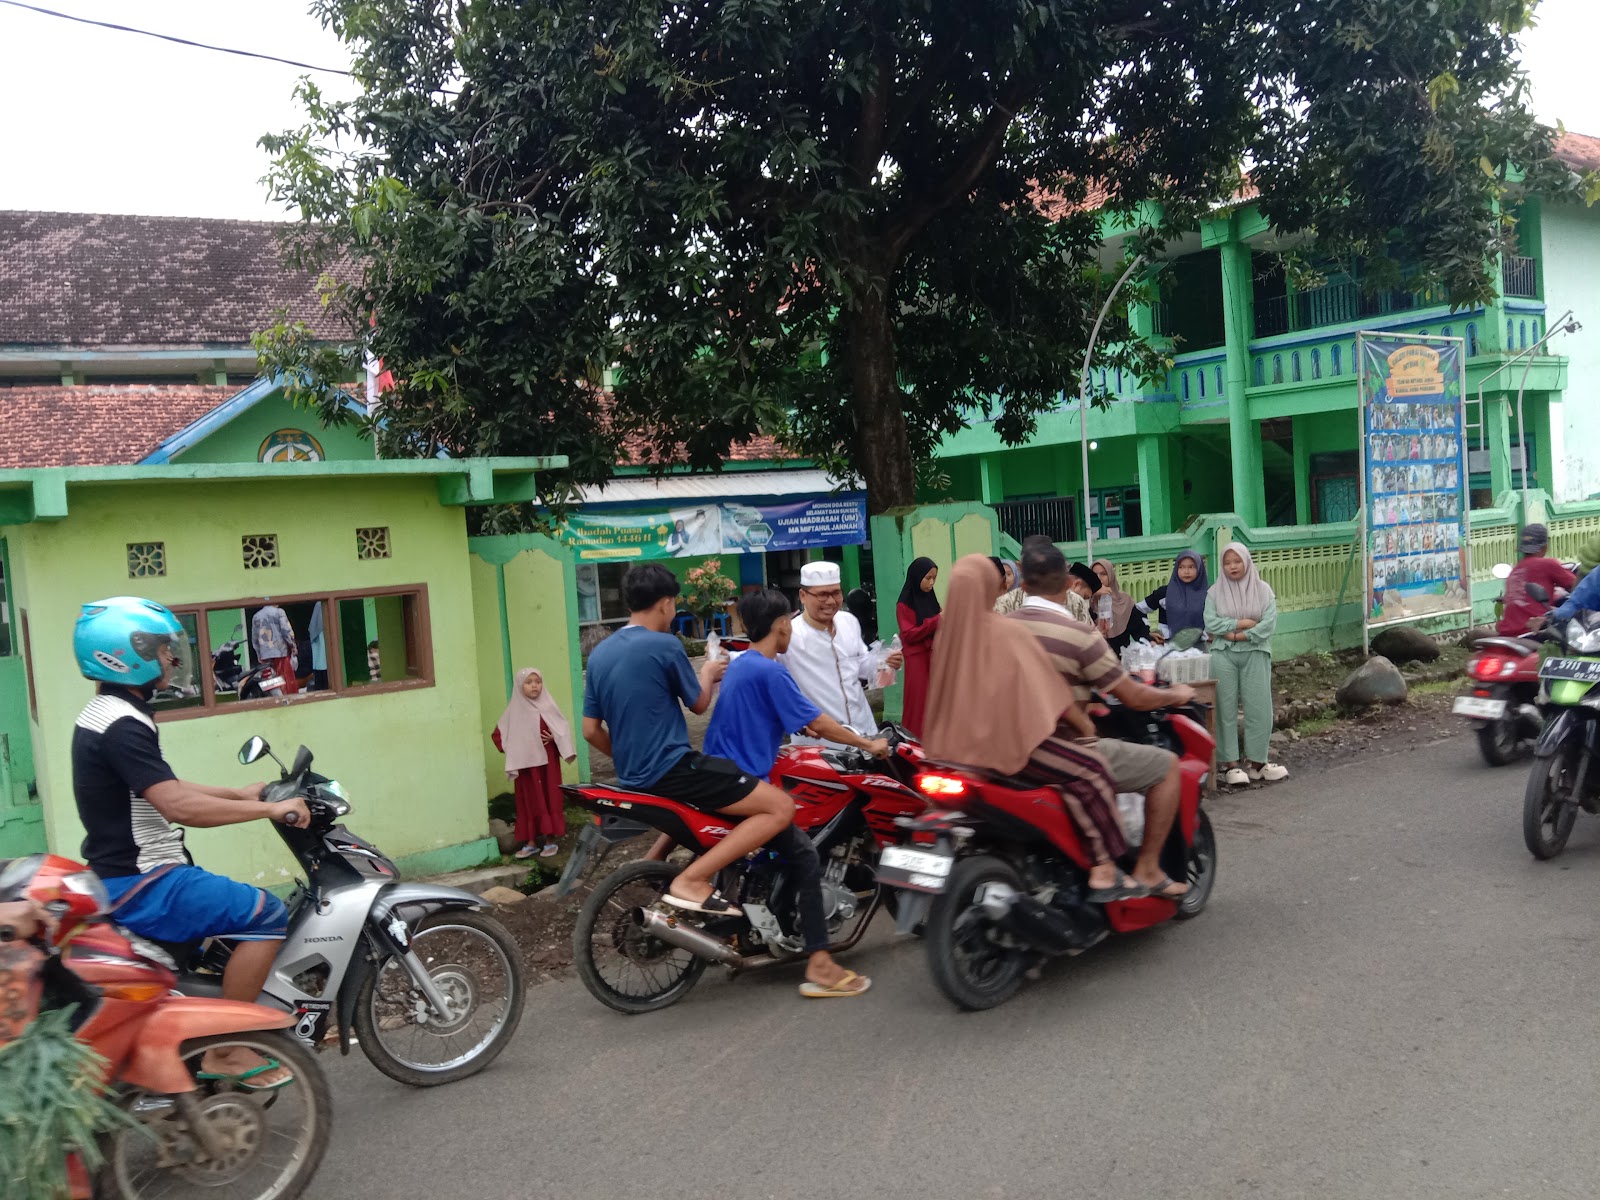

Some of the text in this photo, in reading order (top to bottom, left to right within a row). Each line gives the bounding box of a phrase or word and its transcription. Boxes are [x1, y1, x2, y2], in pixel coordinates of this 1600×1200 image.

[800, 515, 839, 524] MADRASAH
[841, 513, 858, 523] (UM)
[577, 526, 642, 536] Ibadah Puasa
[800, 525, 831, 533] MIFTAHUL
[568, 533, 651, 545] Ramadan 1446 H
[304, 935, 344, 943] HONDA
